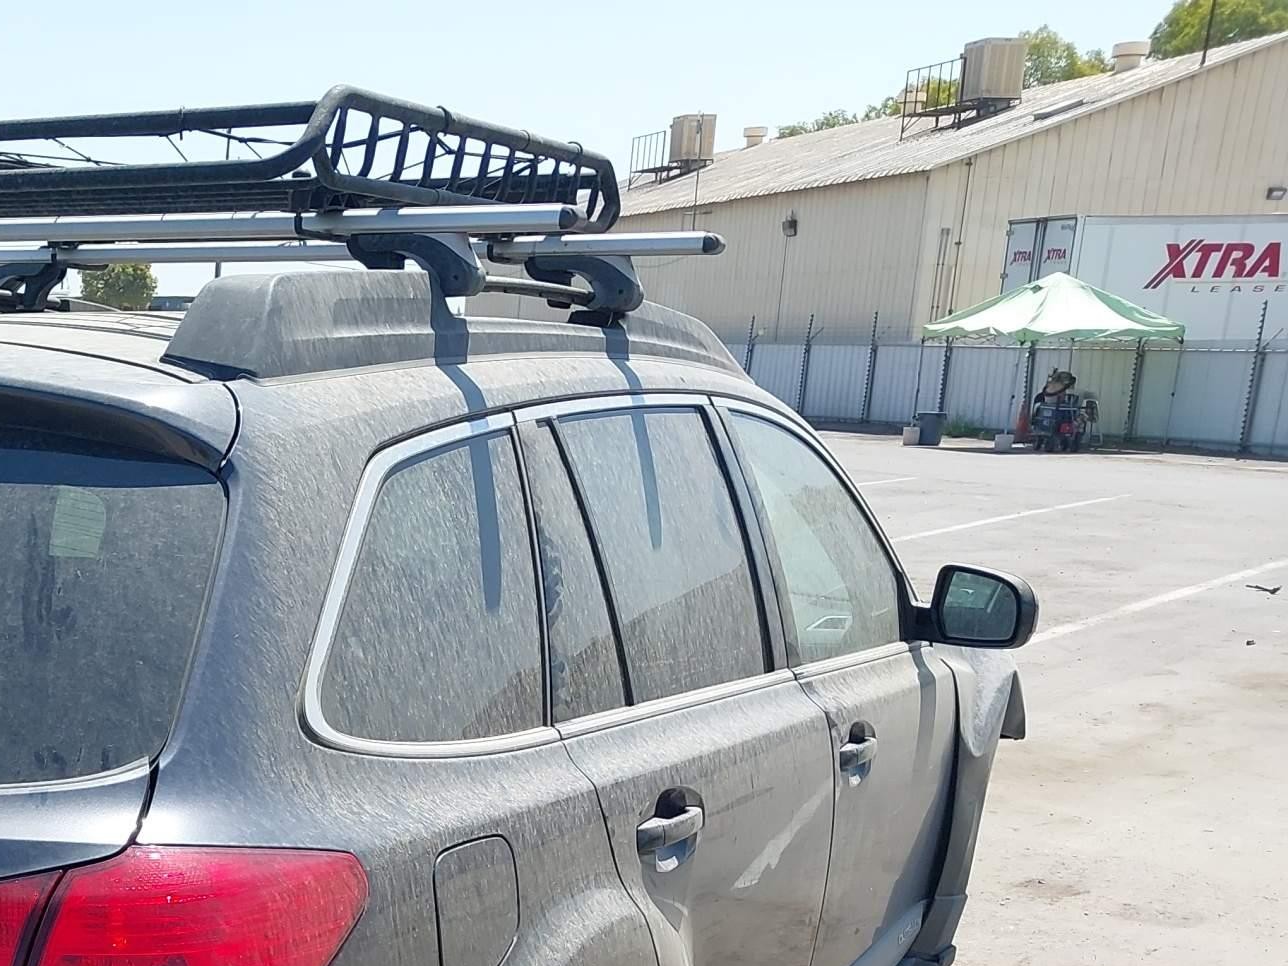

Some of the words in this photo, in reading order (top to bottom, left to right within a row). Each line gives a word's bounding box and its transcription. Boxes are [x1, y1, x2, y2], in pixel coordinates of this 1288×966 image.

[1010, 250, 1032, 265] XTRA
[1043, 248, 1067, 263] XTRA
[1143, 239, 1281, 289] XTRA
[1190, 285, 1288, 293] LEASE
